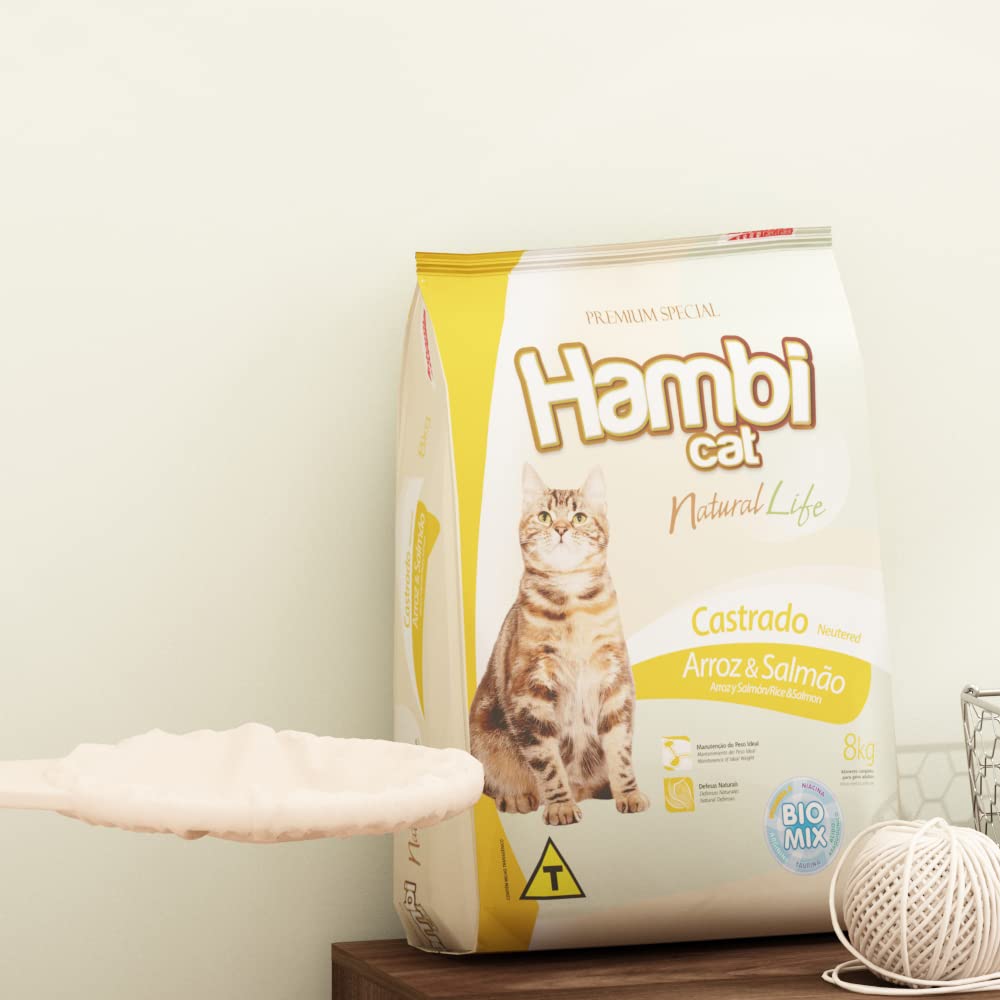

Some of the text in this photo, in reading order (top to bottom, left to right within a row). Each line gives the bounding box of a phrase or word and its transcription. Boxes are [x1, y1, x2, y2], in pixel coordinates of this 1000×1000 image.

[585, 302, 720, 325] PREMIUM SPECIAL
[514, 335, 816, 453] Hambi
[686, 424, 763, 472] cat
[669, 480, 826, 534] Natural Life
[691, 603, 808, 637] Castrado
[816, 624, 861, 644] Neutered
[682, 652, 846, 695] Arroz & Salmão
[843, 732, 875, 767] 8kg
[801, 782, 825, 797] NIACINA
[782, 800, 825, 826] BIO
[784, 825, 828, 851] MIX
[542, 864, 563, 891] T
